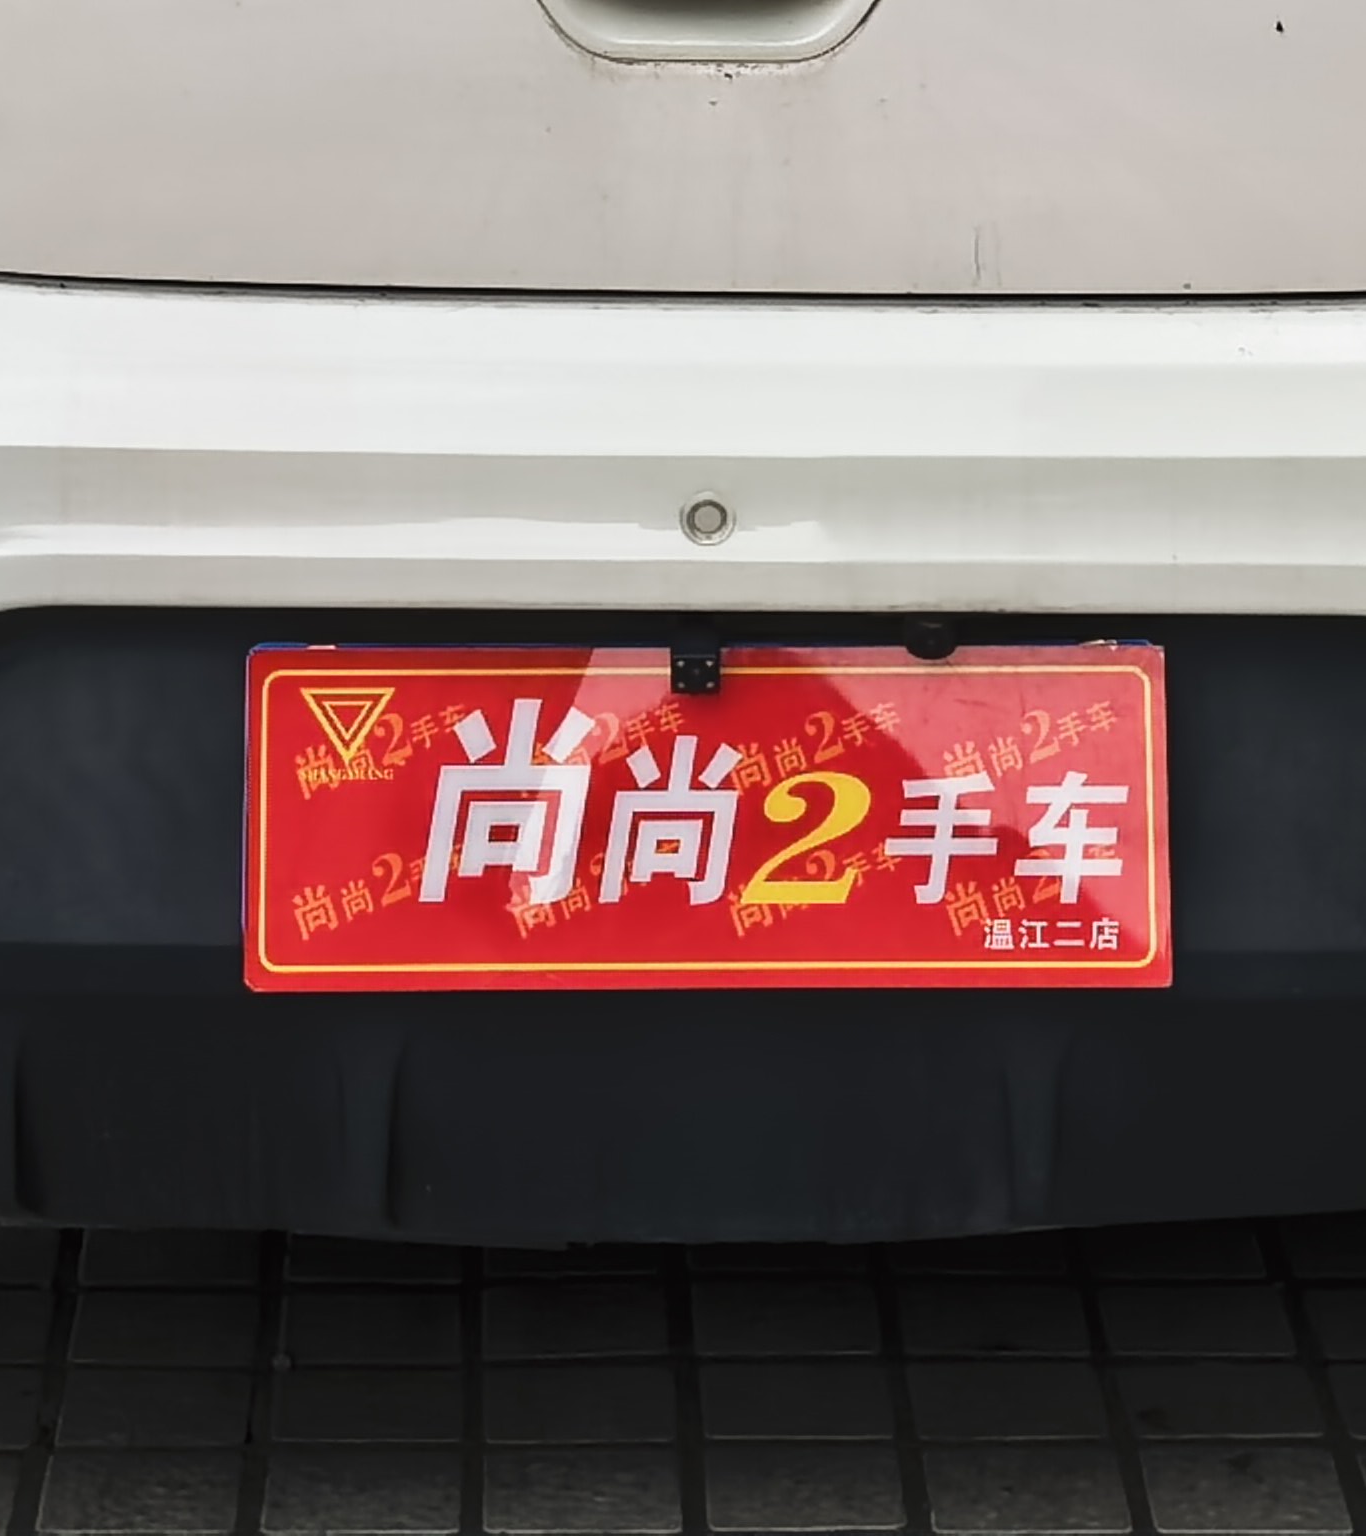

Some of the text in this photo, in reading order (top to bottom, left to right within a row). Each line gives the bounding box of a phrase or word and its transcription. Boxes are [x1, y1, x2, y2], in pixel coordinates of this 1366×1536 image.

[418, 697, 1130, 905] 尚尚2手车
[983, 917, 1121, 951] 温江二店
